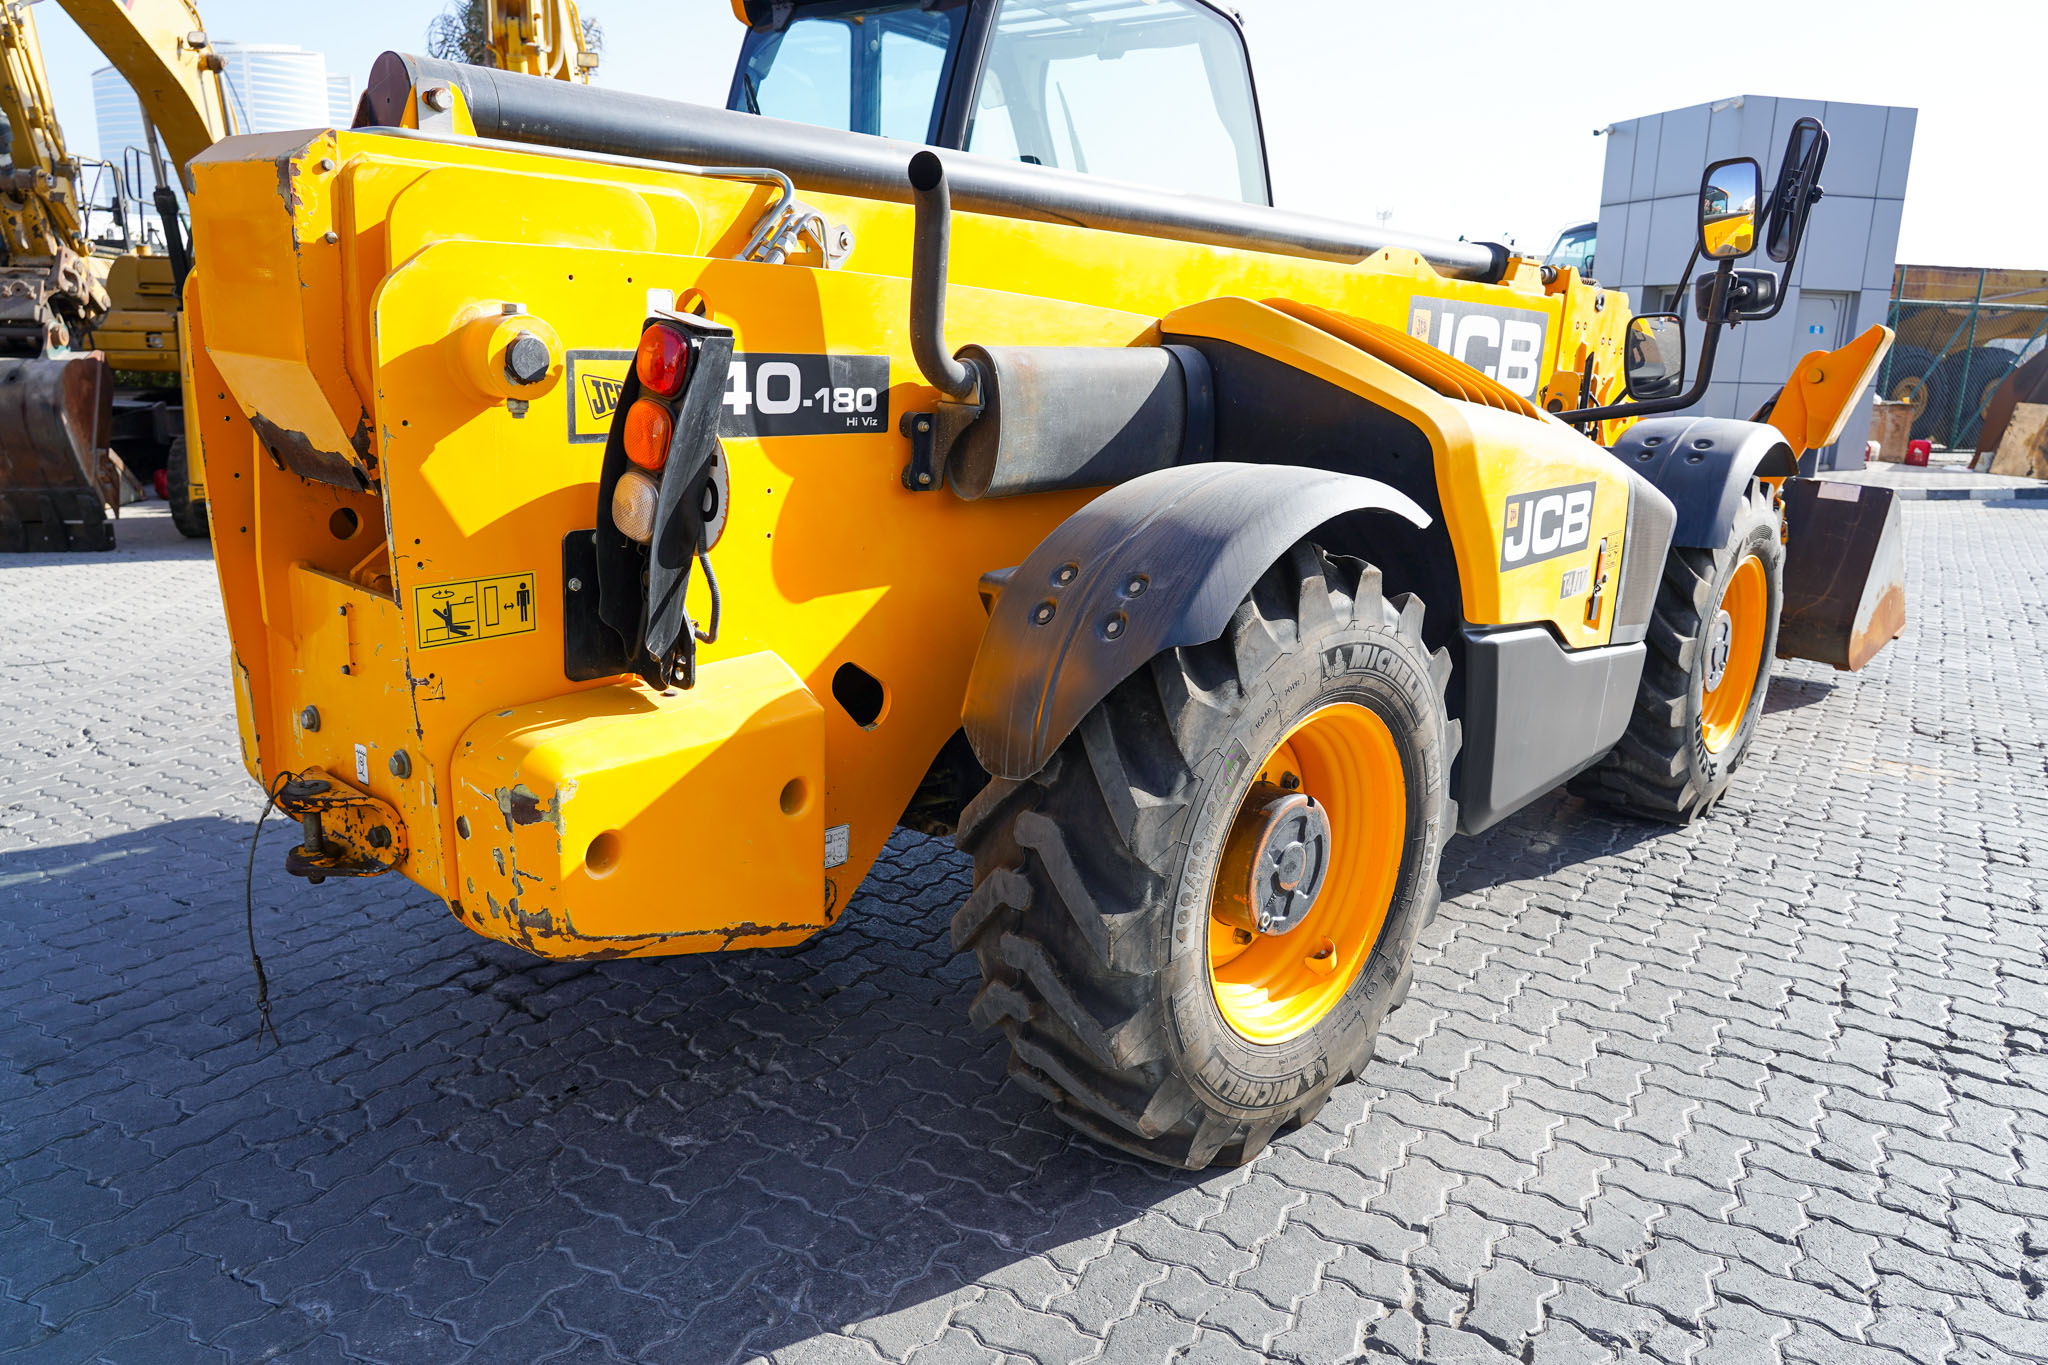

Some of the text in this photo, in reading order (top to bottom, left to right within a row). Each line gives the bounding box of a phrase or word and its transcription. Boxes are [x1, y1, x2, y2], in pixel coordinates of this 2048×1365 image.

[846, 416, 878, 427] Hi Viz
[1504, 490, 1593, 563] JCB
[1348, 644, 1433, 727] MICHELIN
[1200, 1055, 1301, 1108] MICHELIN
